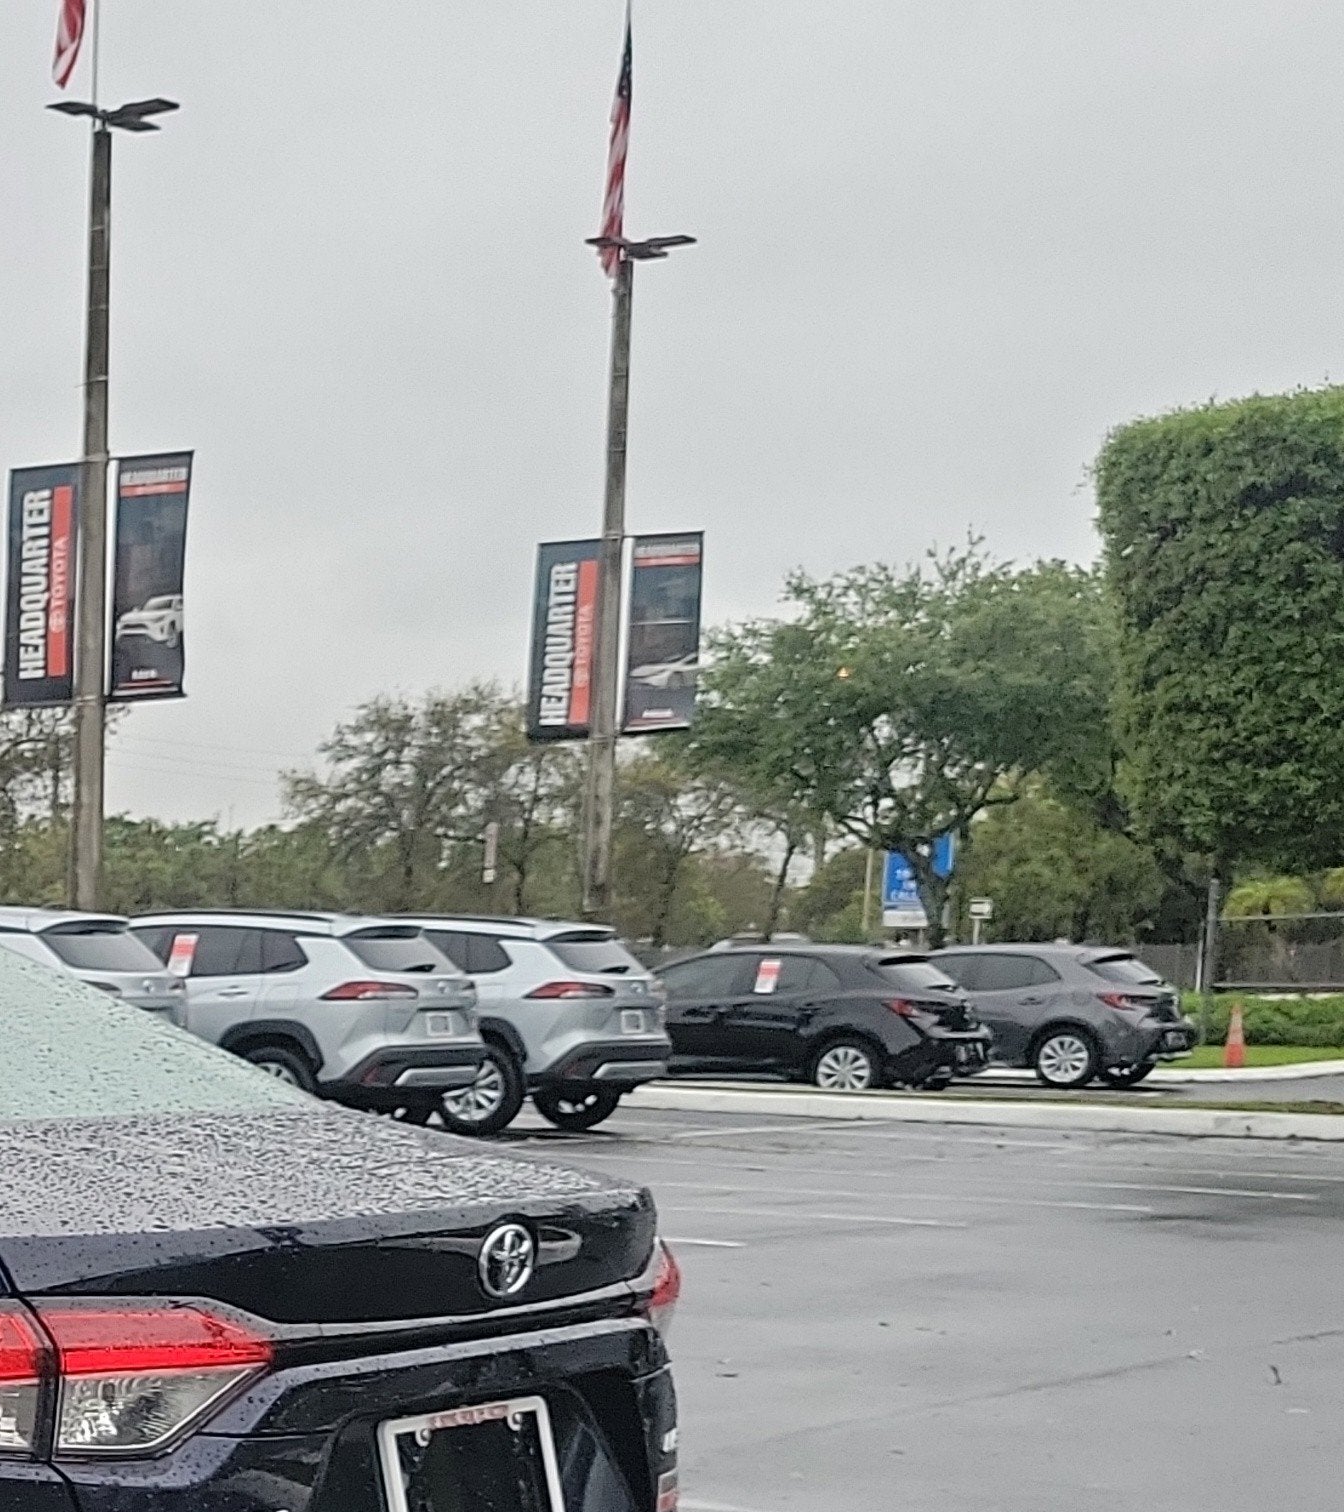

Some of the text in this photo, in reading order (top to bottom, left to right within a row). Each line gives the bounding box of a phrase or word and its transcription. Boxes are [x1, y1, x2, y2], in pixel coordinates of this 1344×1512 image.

[19, 489, 51, 679] HEADQUARTER
[51, 536, 69, 609] TOYOTA
[539, 562, 578, 726] HEADQUARTER
